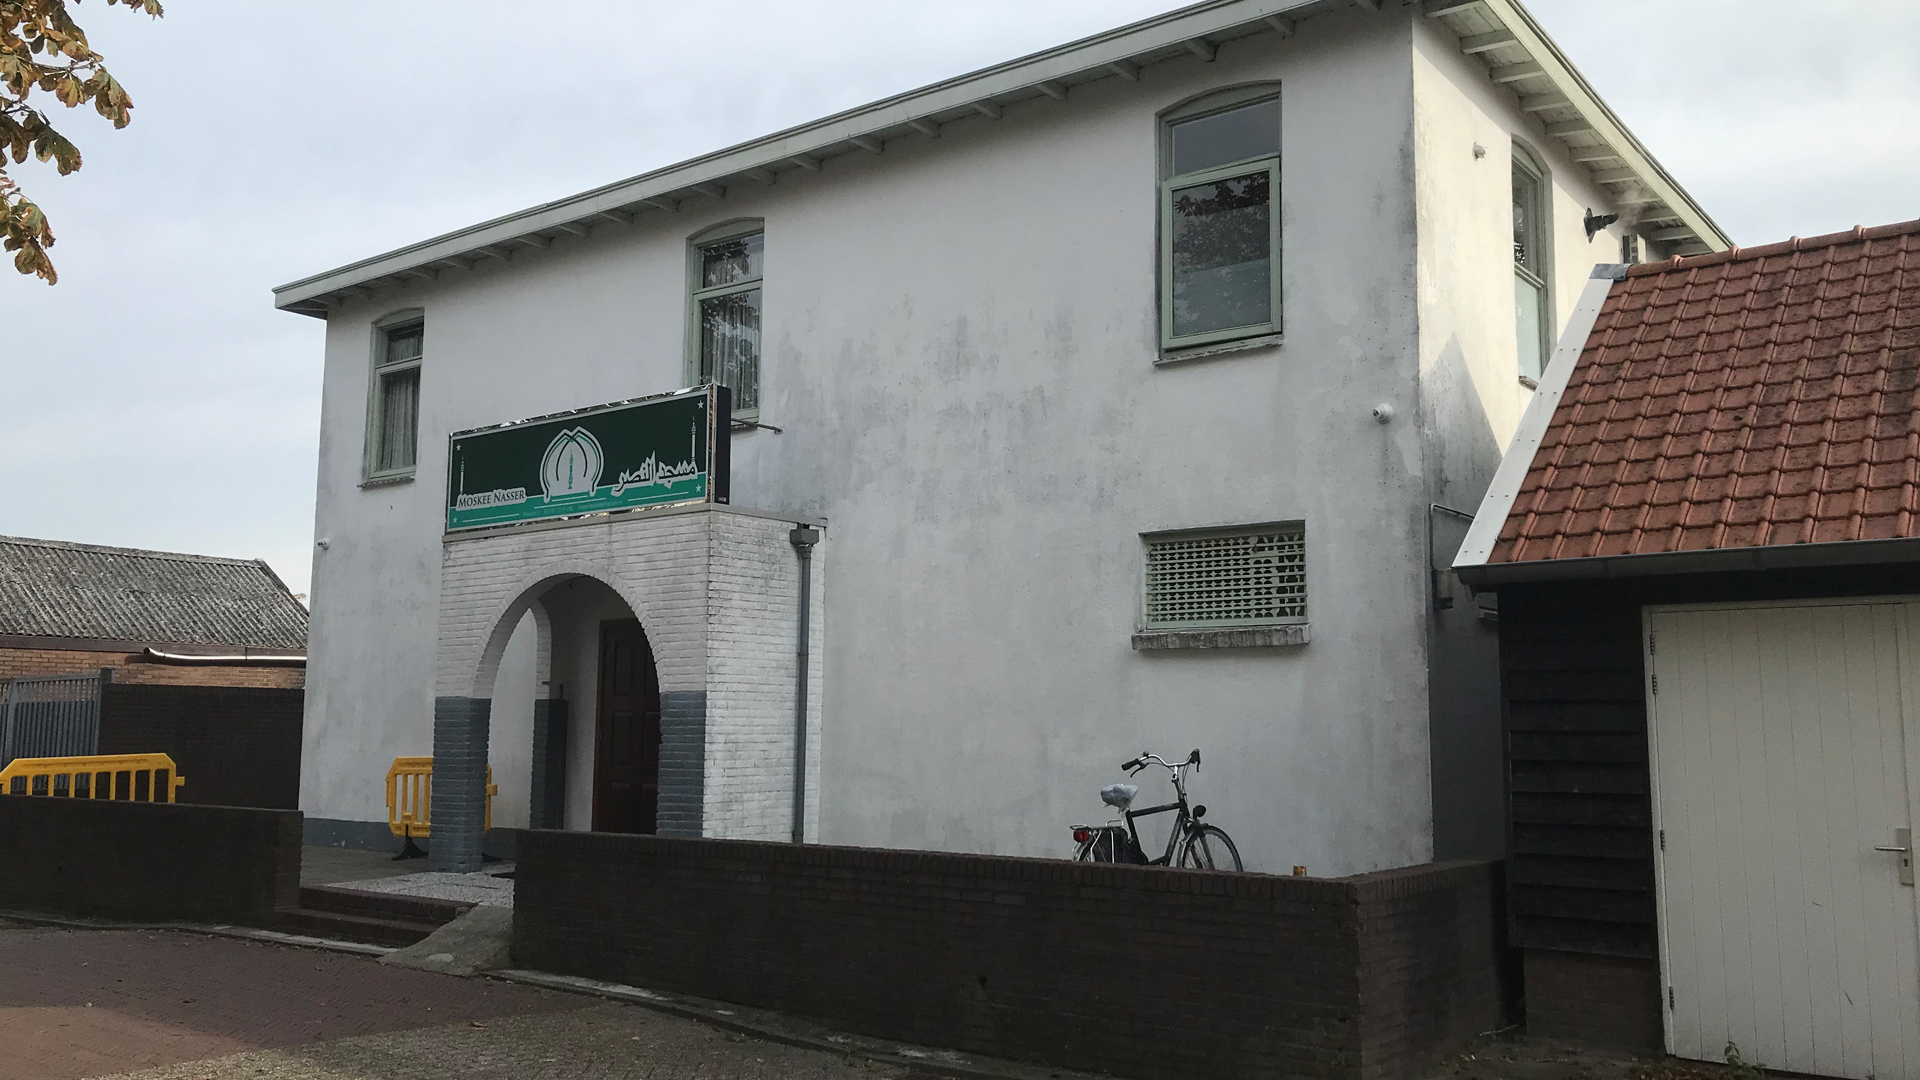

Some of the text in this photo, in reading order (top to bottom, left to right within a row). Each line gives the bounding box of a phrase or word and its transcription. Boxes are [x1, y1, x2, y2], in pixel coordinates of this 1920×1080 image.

[614, 455, 697, 493] مسجد النصر
[458, 489, 525, 508] MOSKEE NASSER
